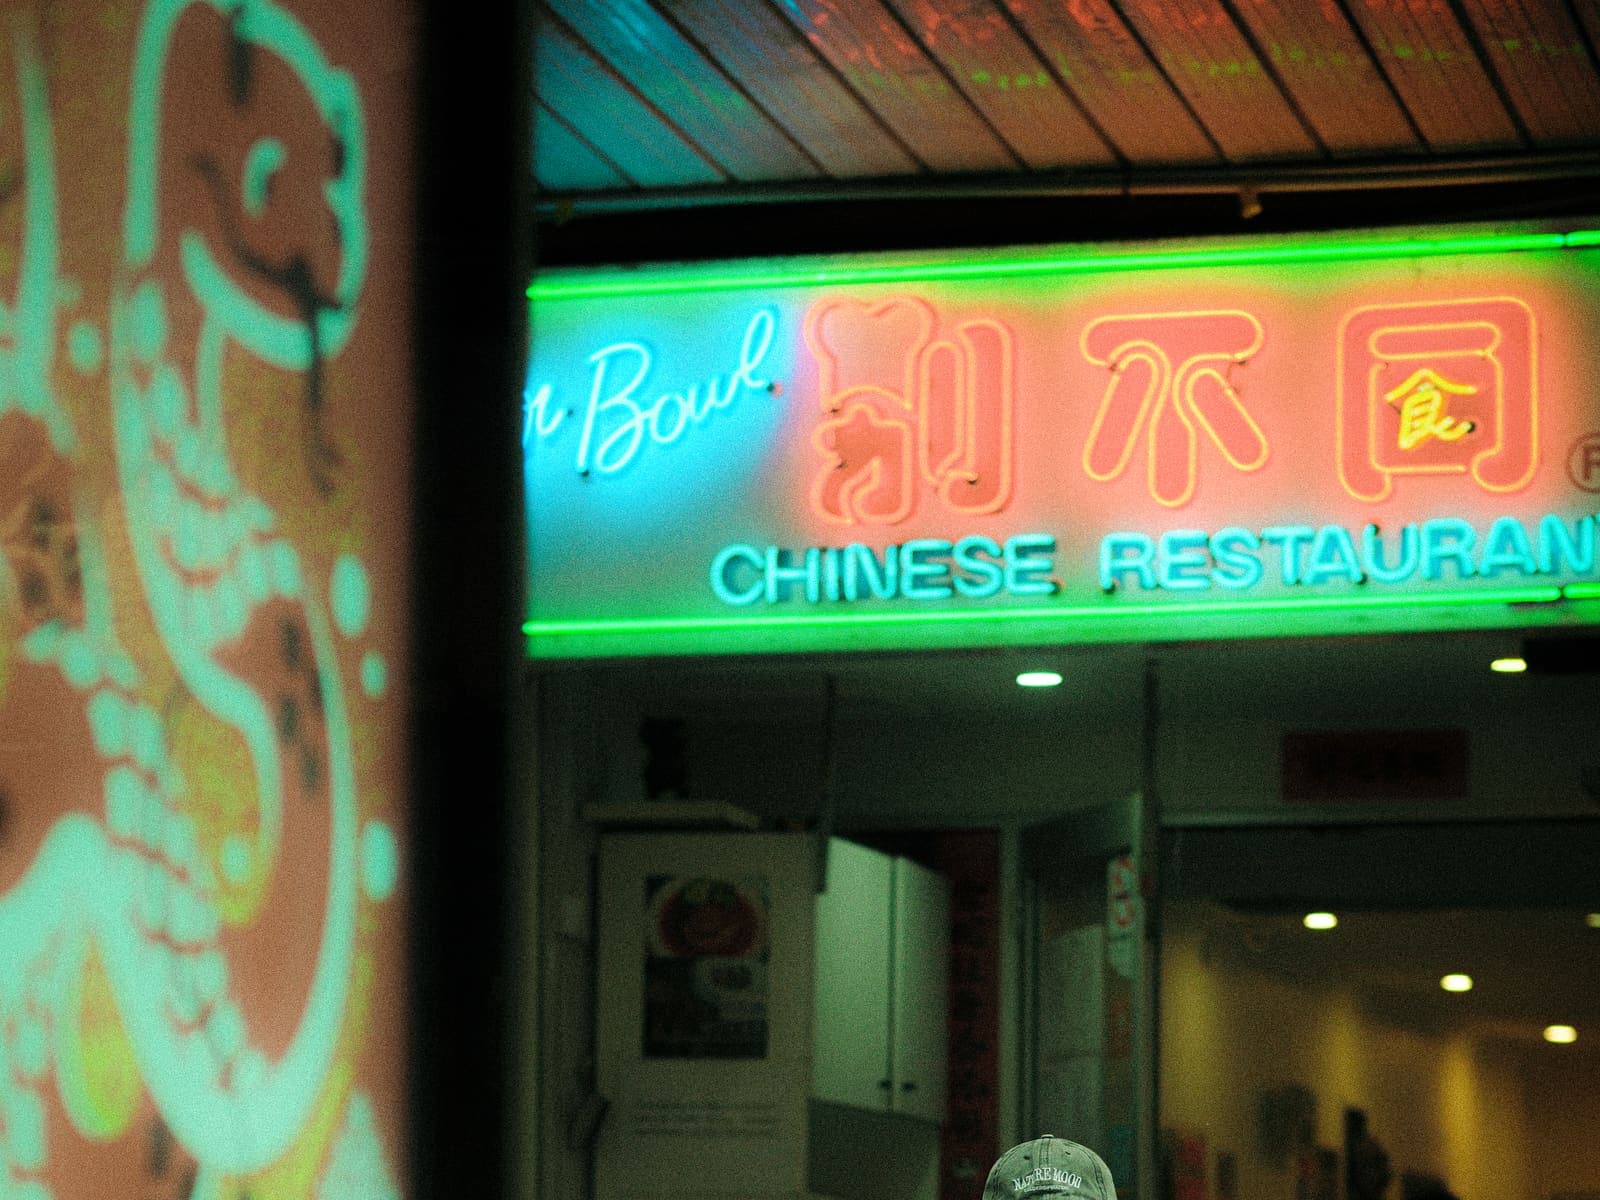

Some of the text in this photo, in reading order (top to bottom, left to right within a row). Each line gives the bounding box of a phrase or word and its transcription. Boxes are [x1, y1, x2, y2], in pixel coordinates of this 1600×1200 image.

[577, 309, 766, 473] Bowl
[710, 514, 1600, 606] CHINESE RESTAURAN
[1053, 1167, 1082, 1189] MOOD
